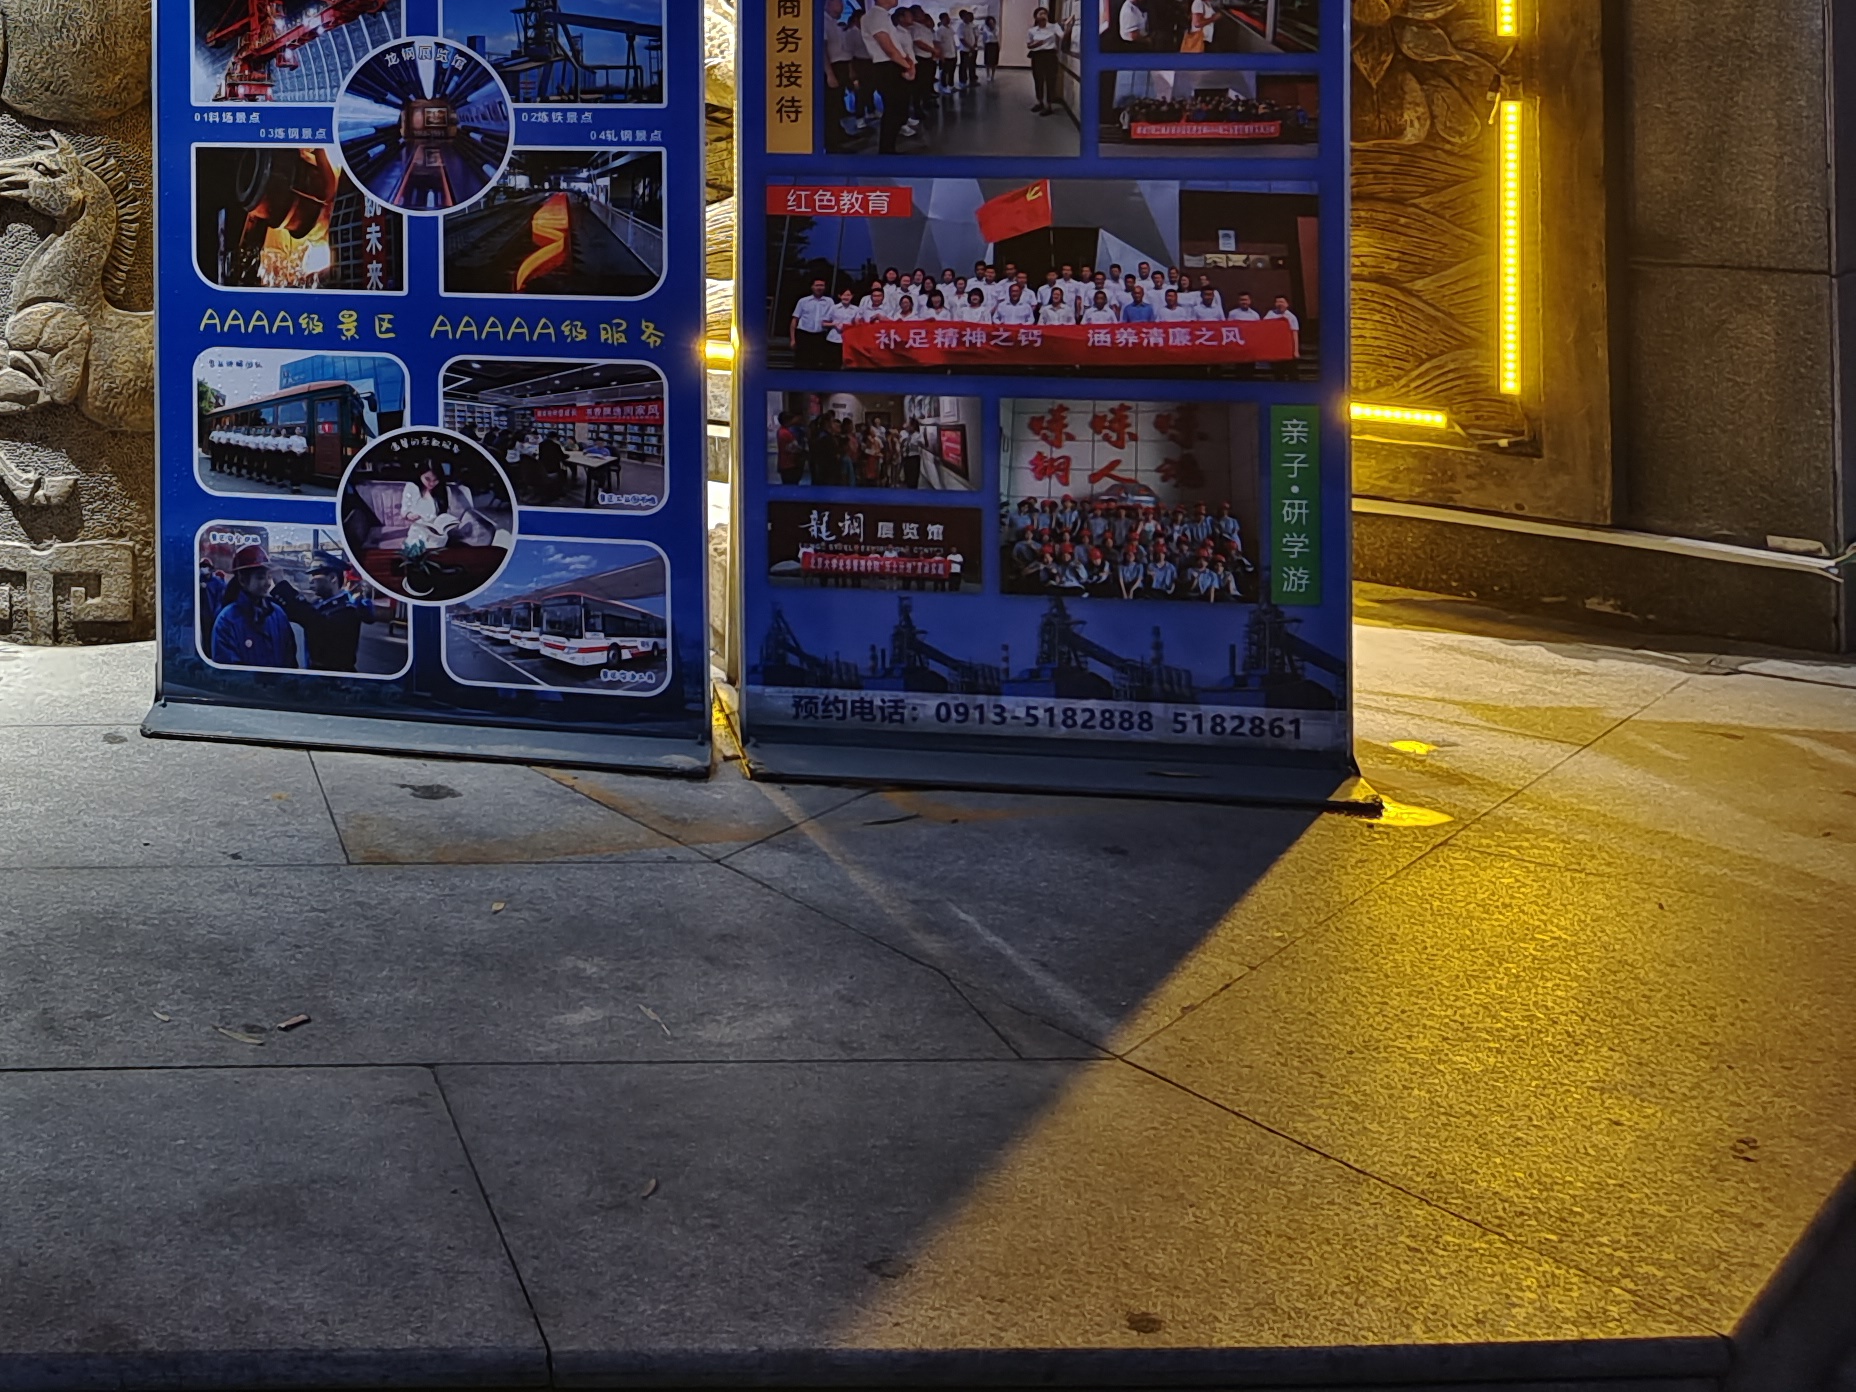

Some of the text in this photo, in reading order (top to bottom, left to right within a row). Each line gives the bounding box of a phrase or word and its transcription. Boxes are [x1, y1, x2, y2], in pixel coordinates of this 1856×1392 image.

[384, 45, 467, 71] 龙钢展览馆
[786, 188, 890, 215] 红色教育
[200, 308, 665, 349] AAAA级景区 AAAAA级服务
[875, 325, 1246, 349] 补足精神之钙 涵养清廉之风
[1281, 418, 1310, 594] 亲子·研学游
[1171, 711, 1304, 741] 5182861
